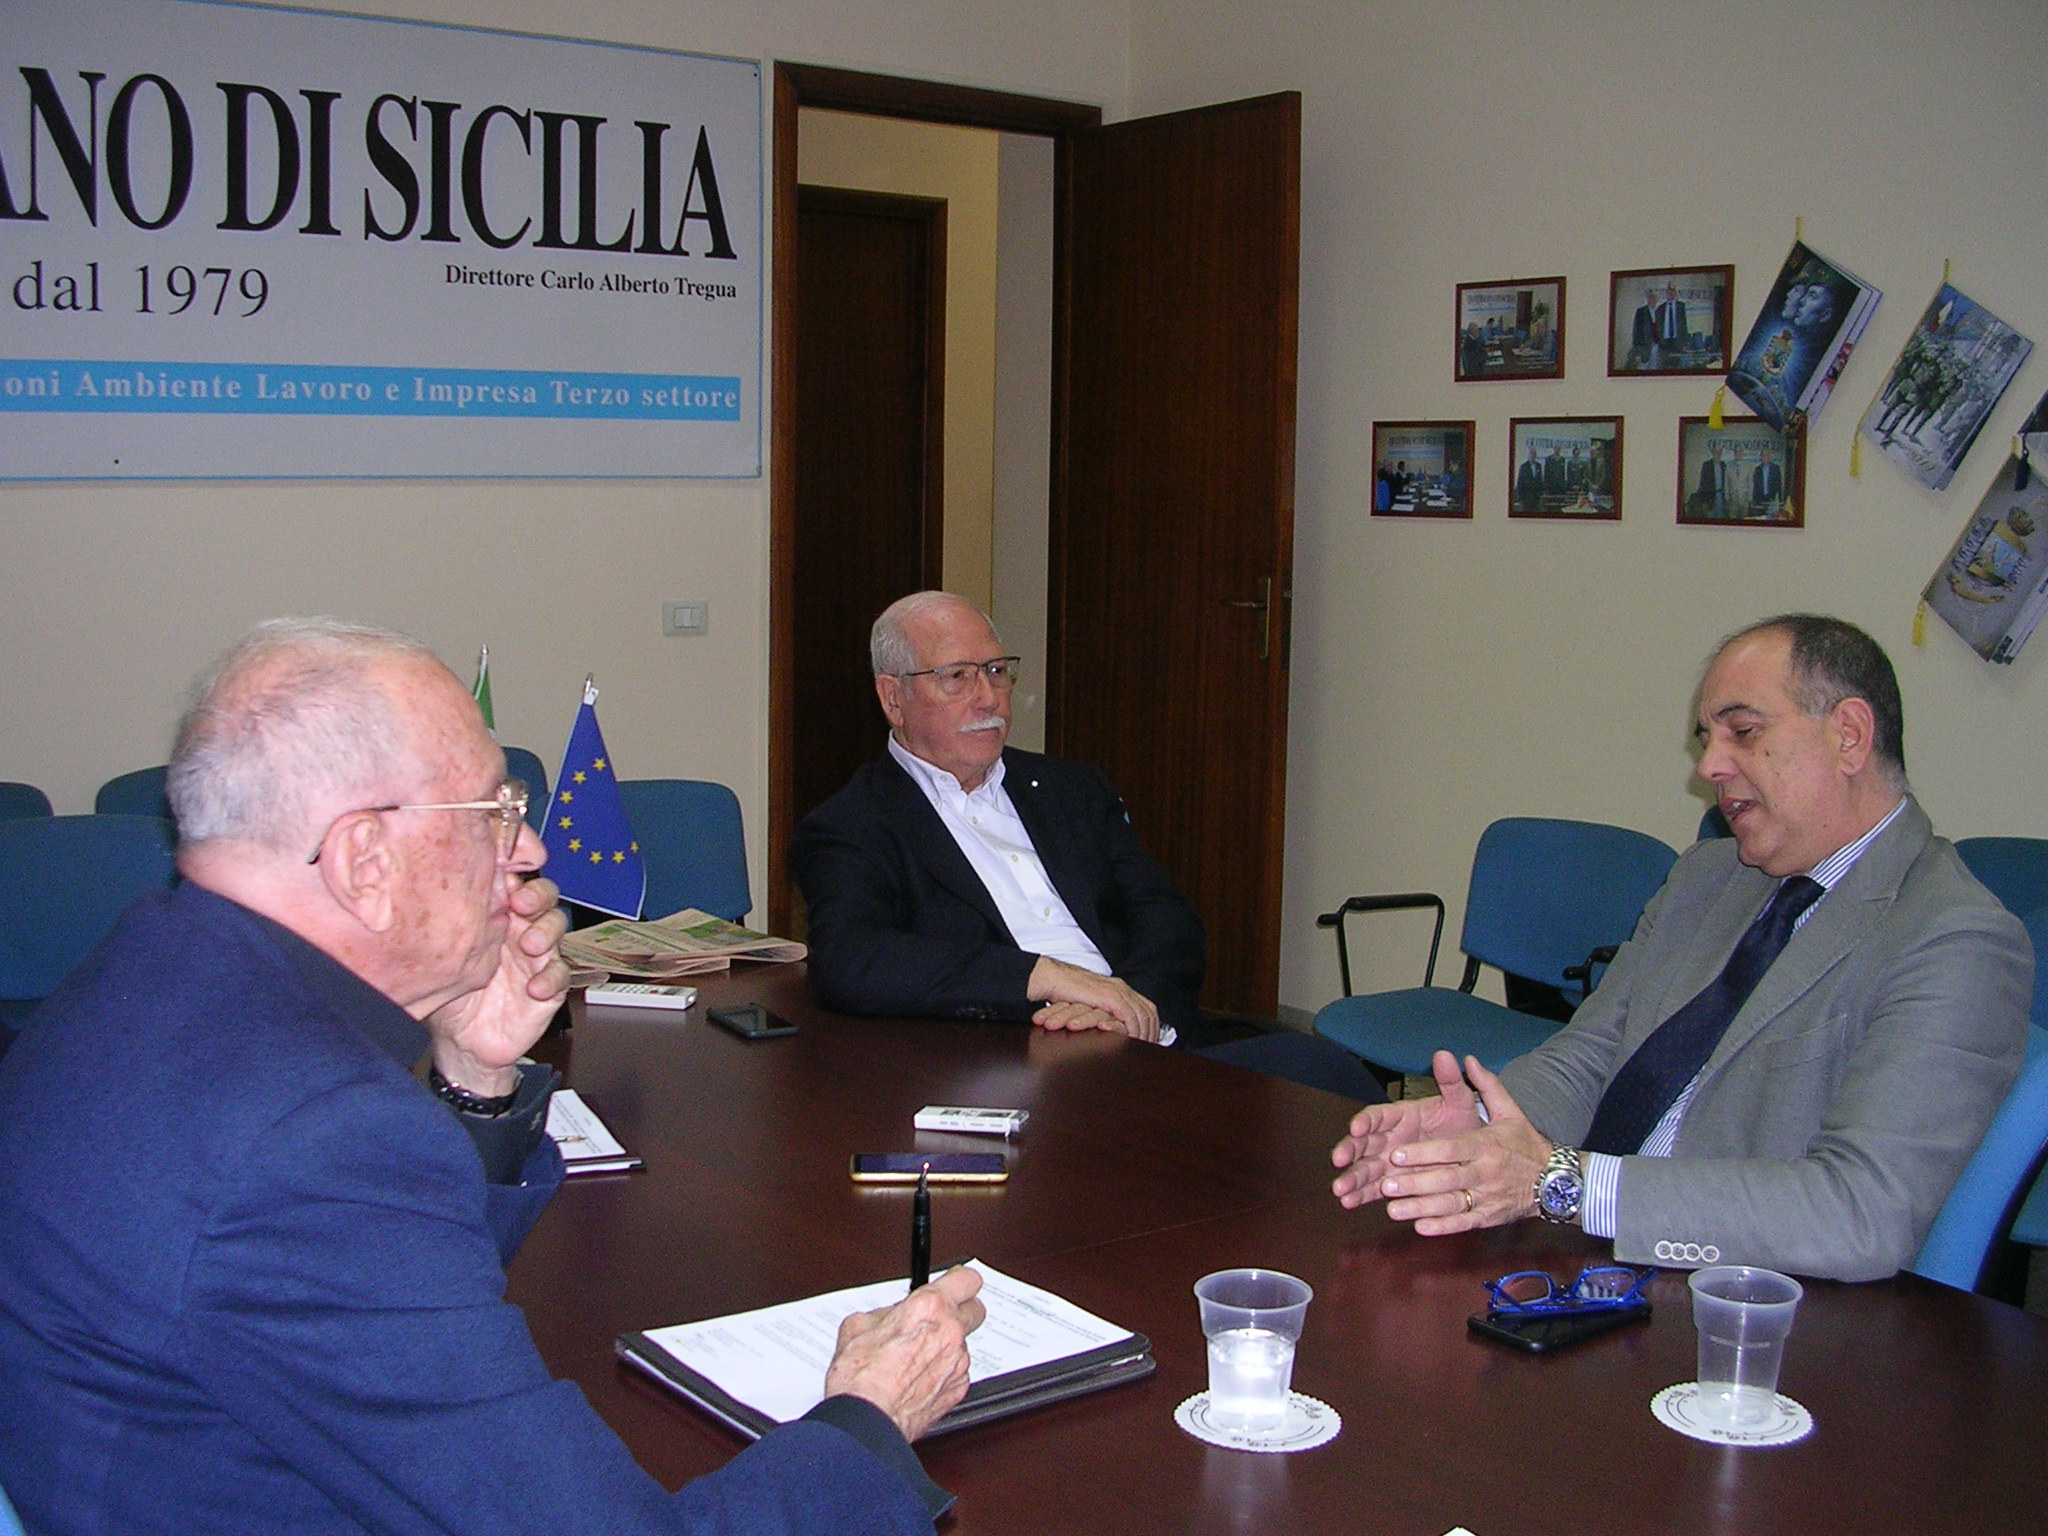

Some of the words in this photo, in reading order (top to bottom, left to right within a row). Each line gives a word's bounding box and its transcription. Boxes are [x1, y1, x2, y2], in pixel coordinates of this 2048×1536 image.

[215, 81, 342, 237] DI
[364, 93, 738, 261] SICILIA
[12, 260, 103, 312] dal
[135, 264, 269, 318] 1979
[445, 264, 535, 288] Direttore
[541, 269, 595, 291] Carlo
[599, 273, 670, 295] Alberto
[674, 277, 737, 301] Tregua
[75, 370, 242, 399] Ambiente
[256, 372, 373, 401] Lavoro
[385, 381, 400, 401] e
[413, 376, 537, 408] Impresa
[550, 380, 630, 405] Terzo
[641, 386, 738, 408] settore
